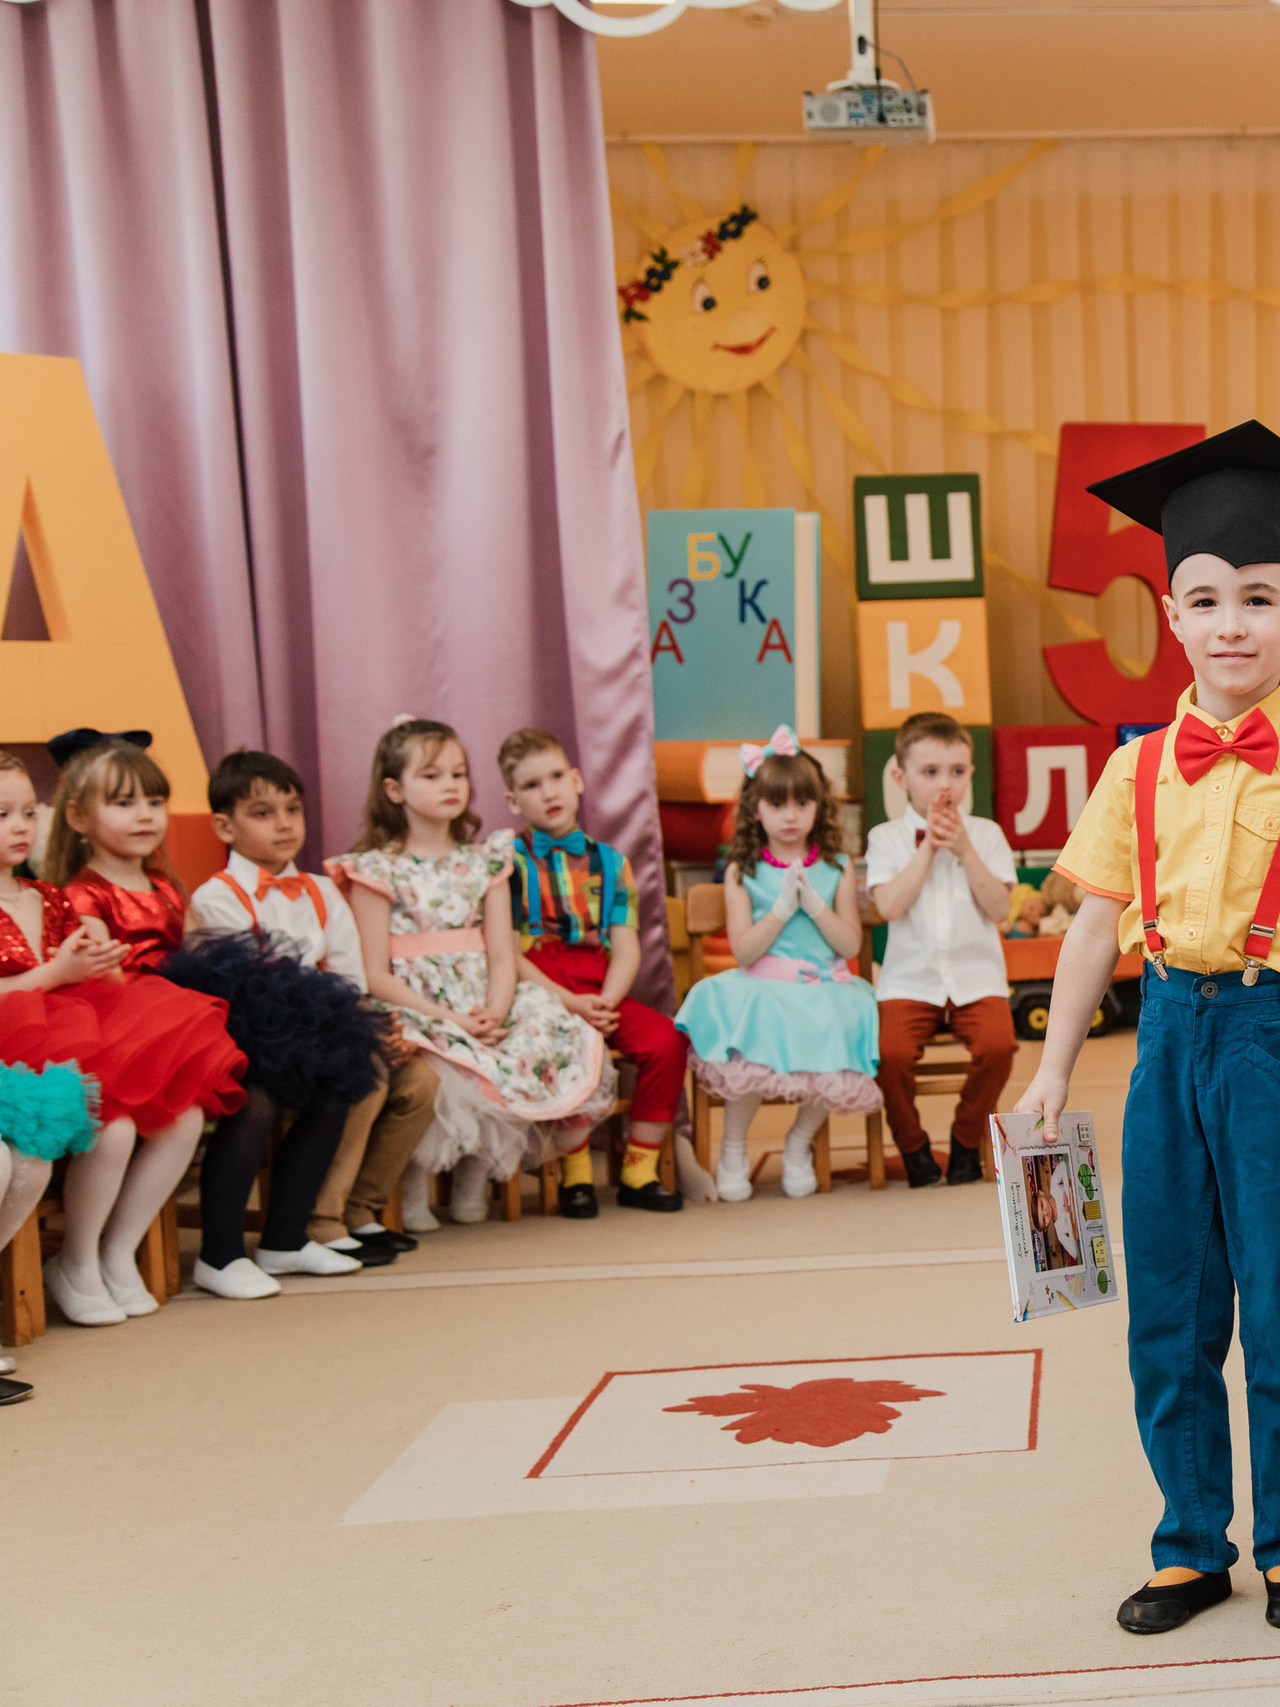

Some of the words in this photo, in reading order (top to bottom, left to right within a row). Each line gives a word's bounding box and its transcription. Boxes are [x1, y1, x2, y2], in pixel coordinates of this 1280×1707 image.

[863, 492, 976, 584] Ш
[1043, 422, 1206, 726] 5
[886, 620, 965, 709] К
[1014, 745, 1089, 836] Л
